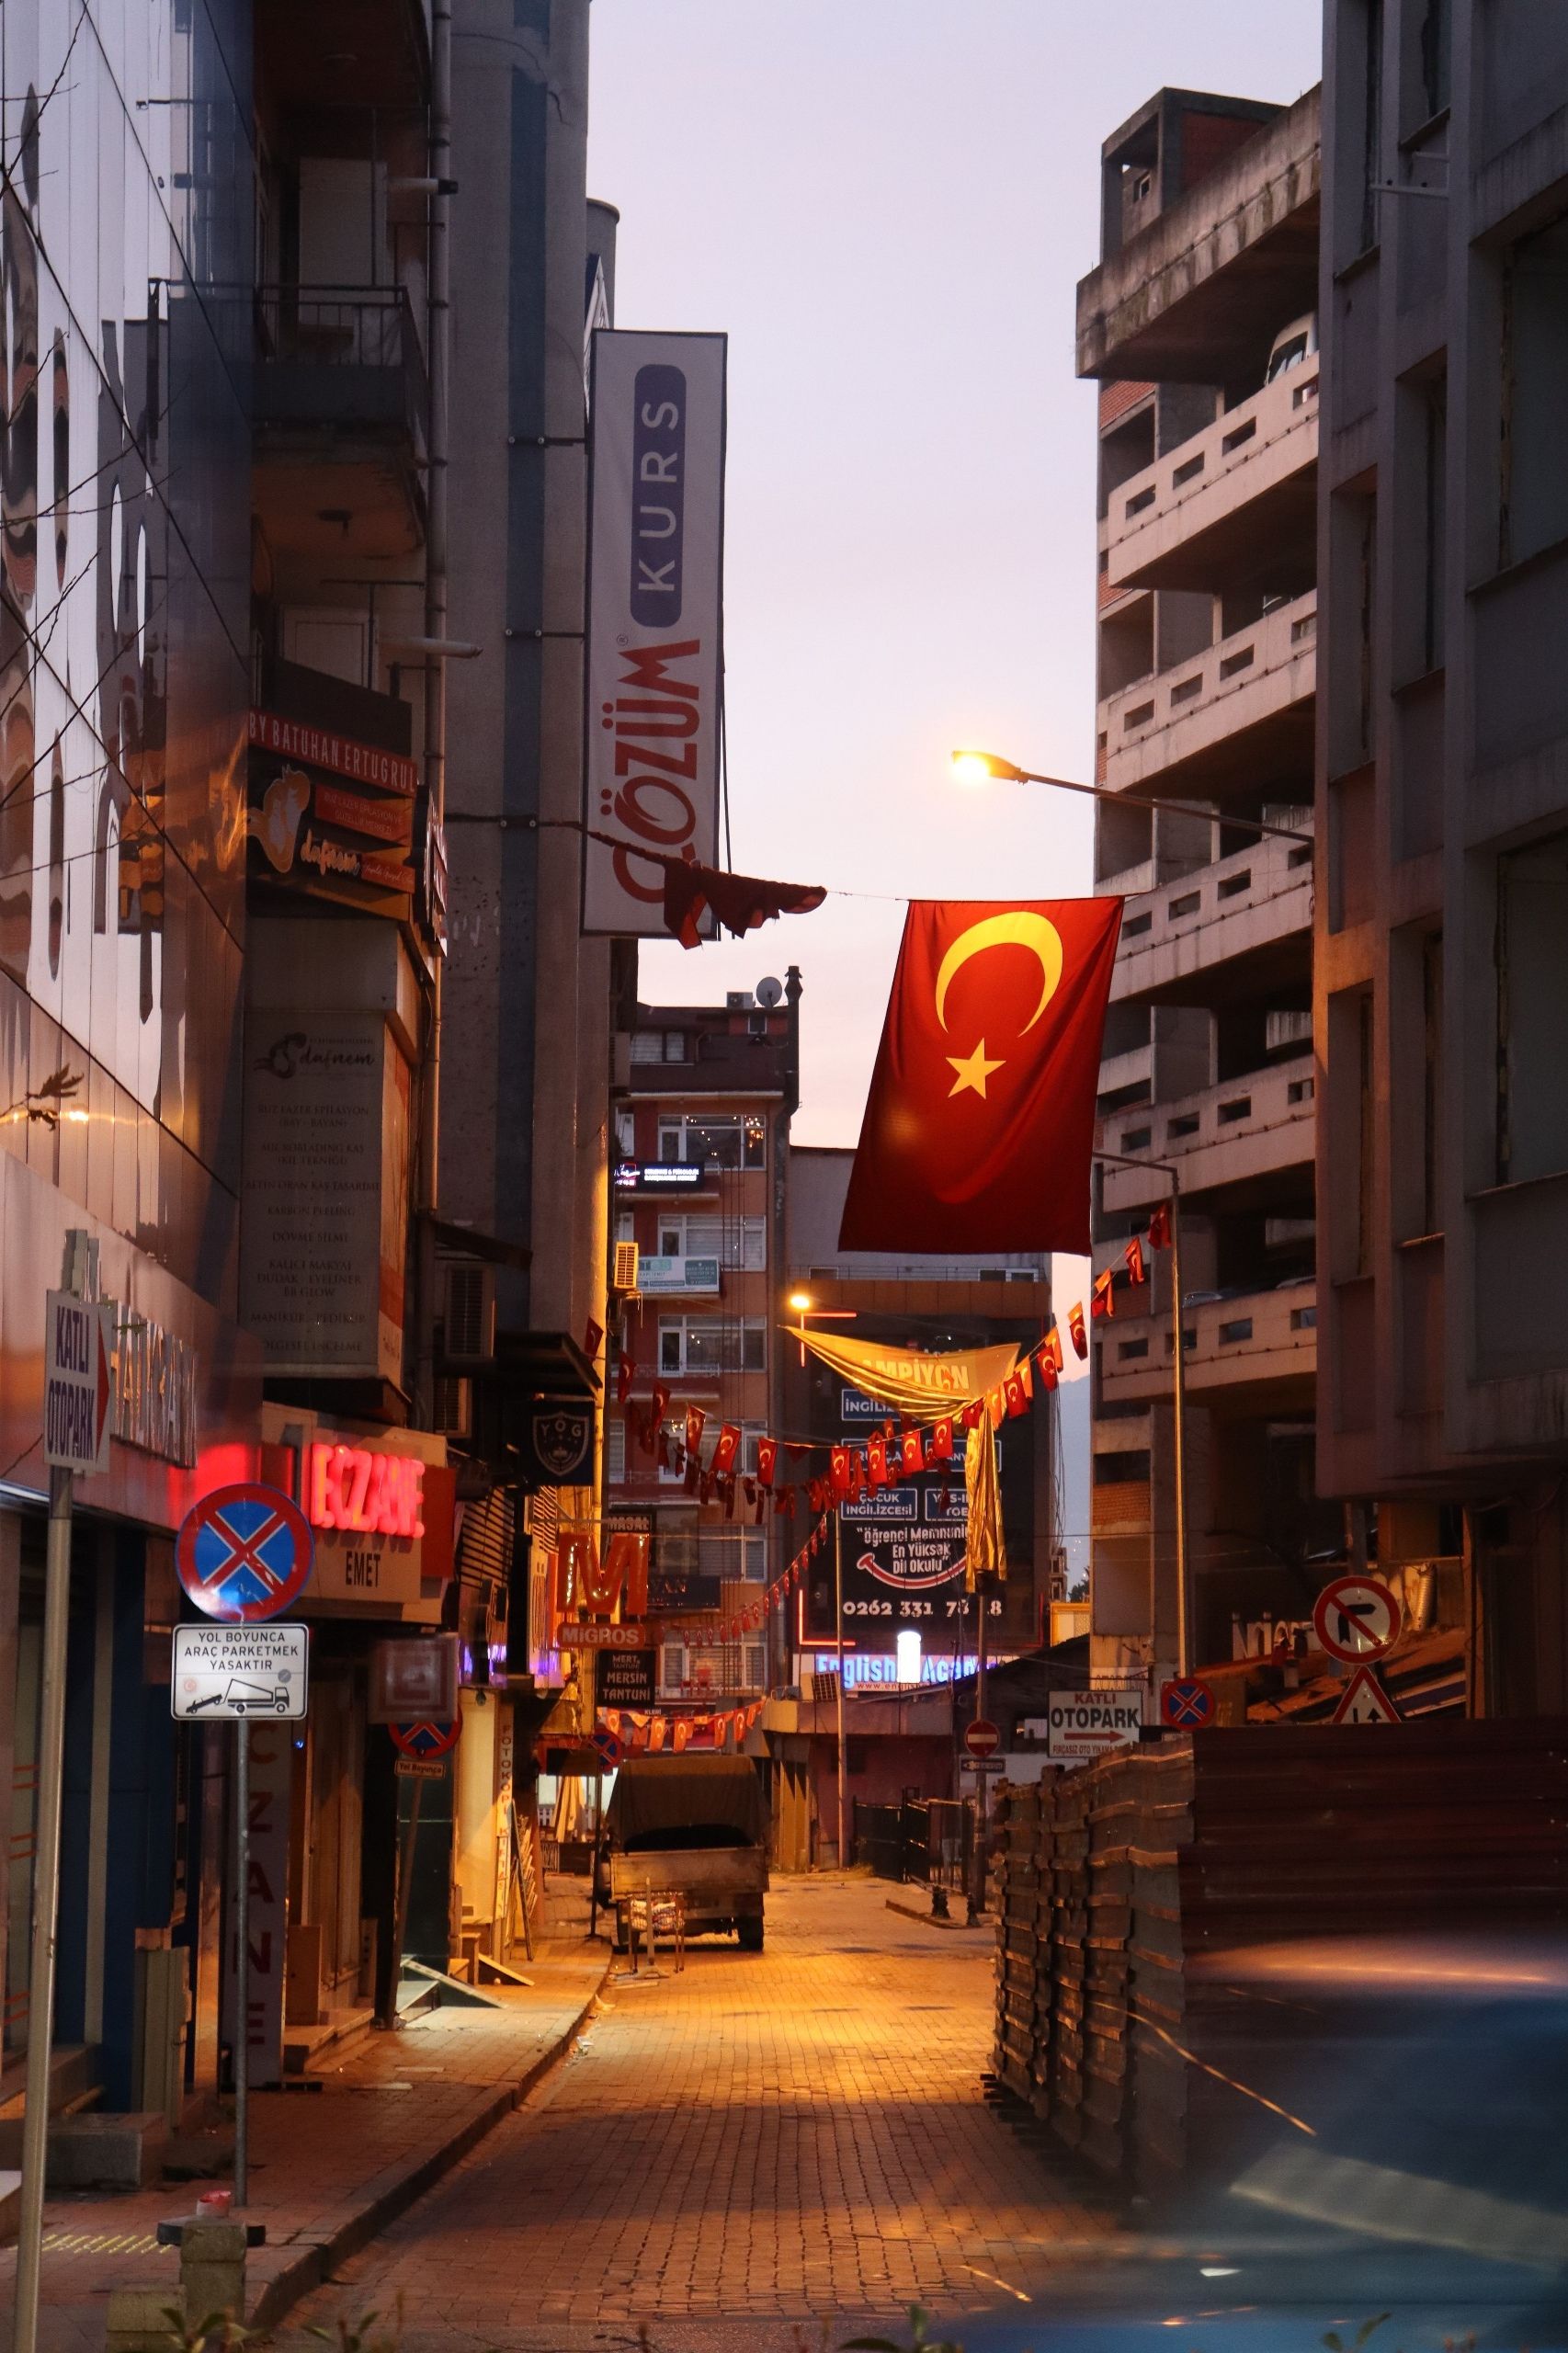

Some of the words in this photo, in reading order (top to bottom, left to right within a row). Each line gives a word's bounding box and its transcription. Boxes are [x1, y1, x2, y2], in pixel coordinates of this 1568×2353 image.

[638, 400, 679, 593] KURS
[249, 712, 267, 743] BY
[272, 720, 339, 767] BATUHAN
[55, 1304, 90, 1374] KATLI
[862, 1358, 971, 1390] MPİYON
[47, 1379, 95, 1461] OTOPARK
[311, 1443, 426, 1540] ECZANE
[892, 1544, 905, 1559] En
[907, 1542, 952, 1558] Yüksek
[345, 1551, 381, 1588] EMET
[556, 1531, 651, 1616] M
[892, 1559, 907, 1574] Dil
[842, 1599, 892, 1616] 0262
[899, 1601, 934, 1618] 331
[199, 1631, 222, 1643] YOL
[225, 1631, 286, 1643] BOYUNCA
[184, 1646, 219, 1657] ARAÇ
[222, 1645, 299, 1656] PARKETMEK
[210, 1660, 273, 1670] YASAKTIR
[817, 1655, 897, 1689] English
[607, 1670, 648, 1684] MERSİN
[602, 1686, 651, 1700] TANTUNİ
[1074, 1692, 1117, 1705] KATLI
[1051, 1708, 1141, 1729] OTOPARK
